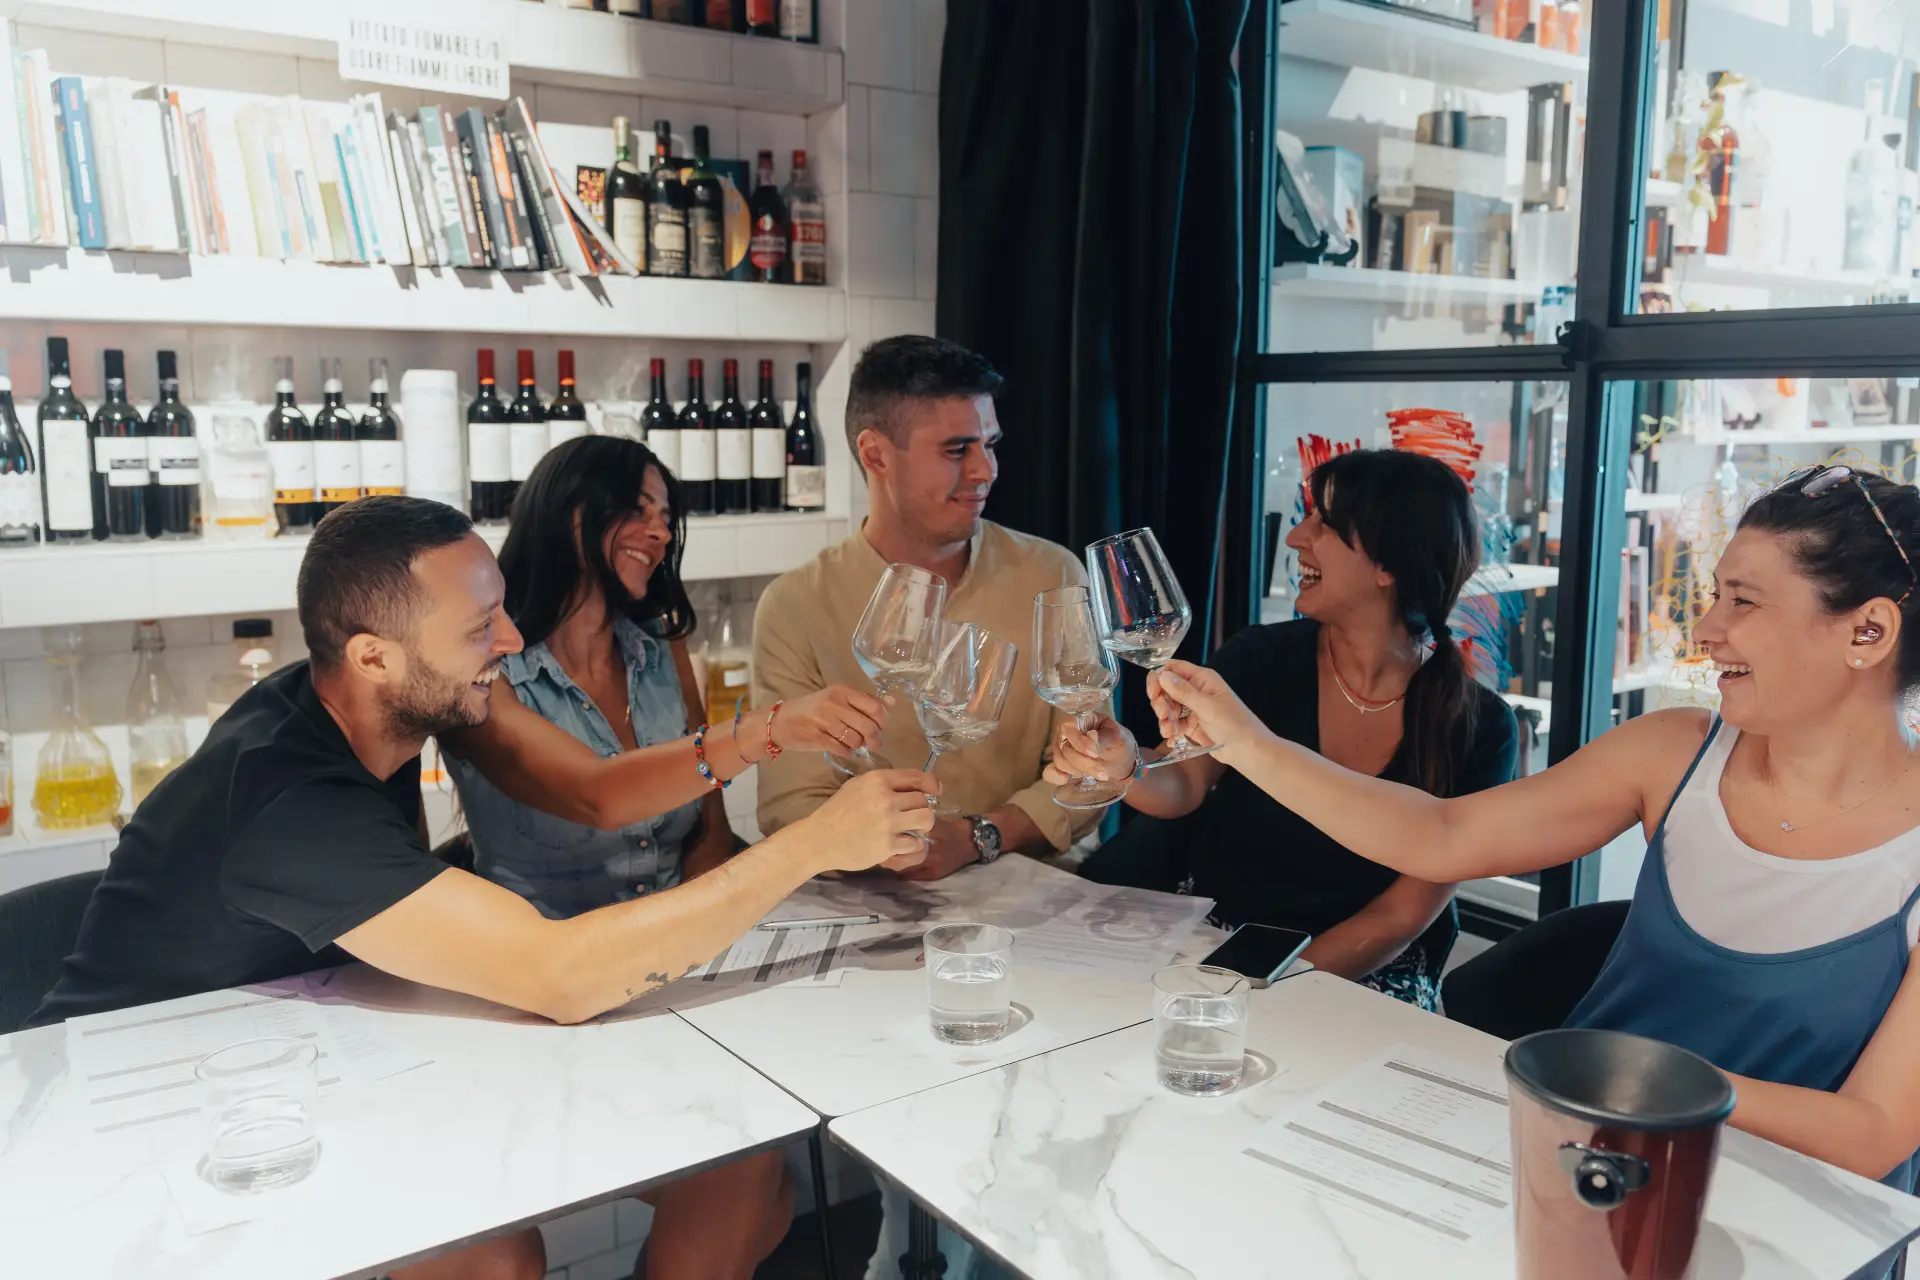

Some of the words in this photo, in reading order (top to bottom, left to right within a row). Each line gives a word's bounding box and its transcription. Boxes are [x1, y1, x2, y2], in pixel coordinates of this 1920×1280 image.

[350, 19, 406, 46] VIETATO
[415, 30, 469, 56] FUMARE
[475, 38, 500, 61] E/O
[350, 48, 390, 72] USARE
[396, 54, 448, 81] FIAMME
[454, 63, 500, 89] LIBERE
[428, 145, 461, 227] PUGLIA
